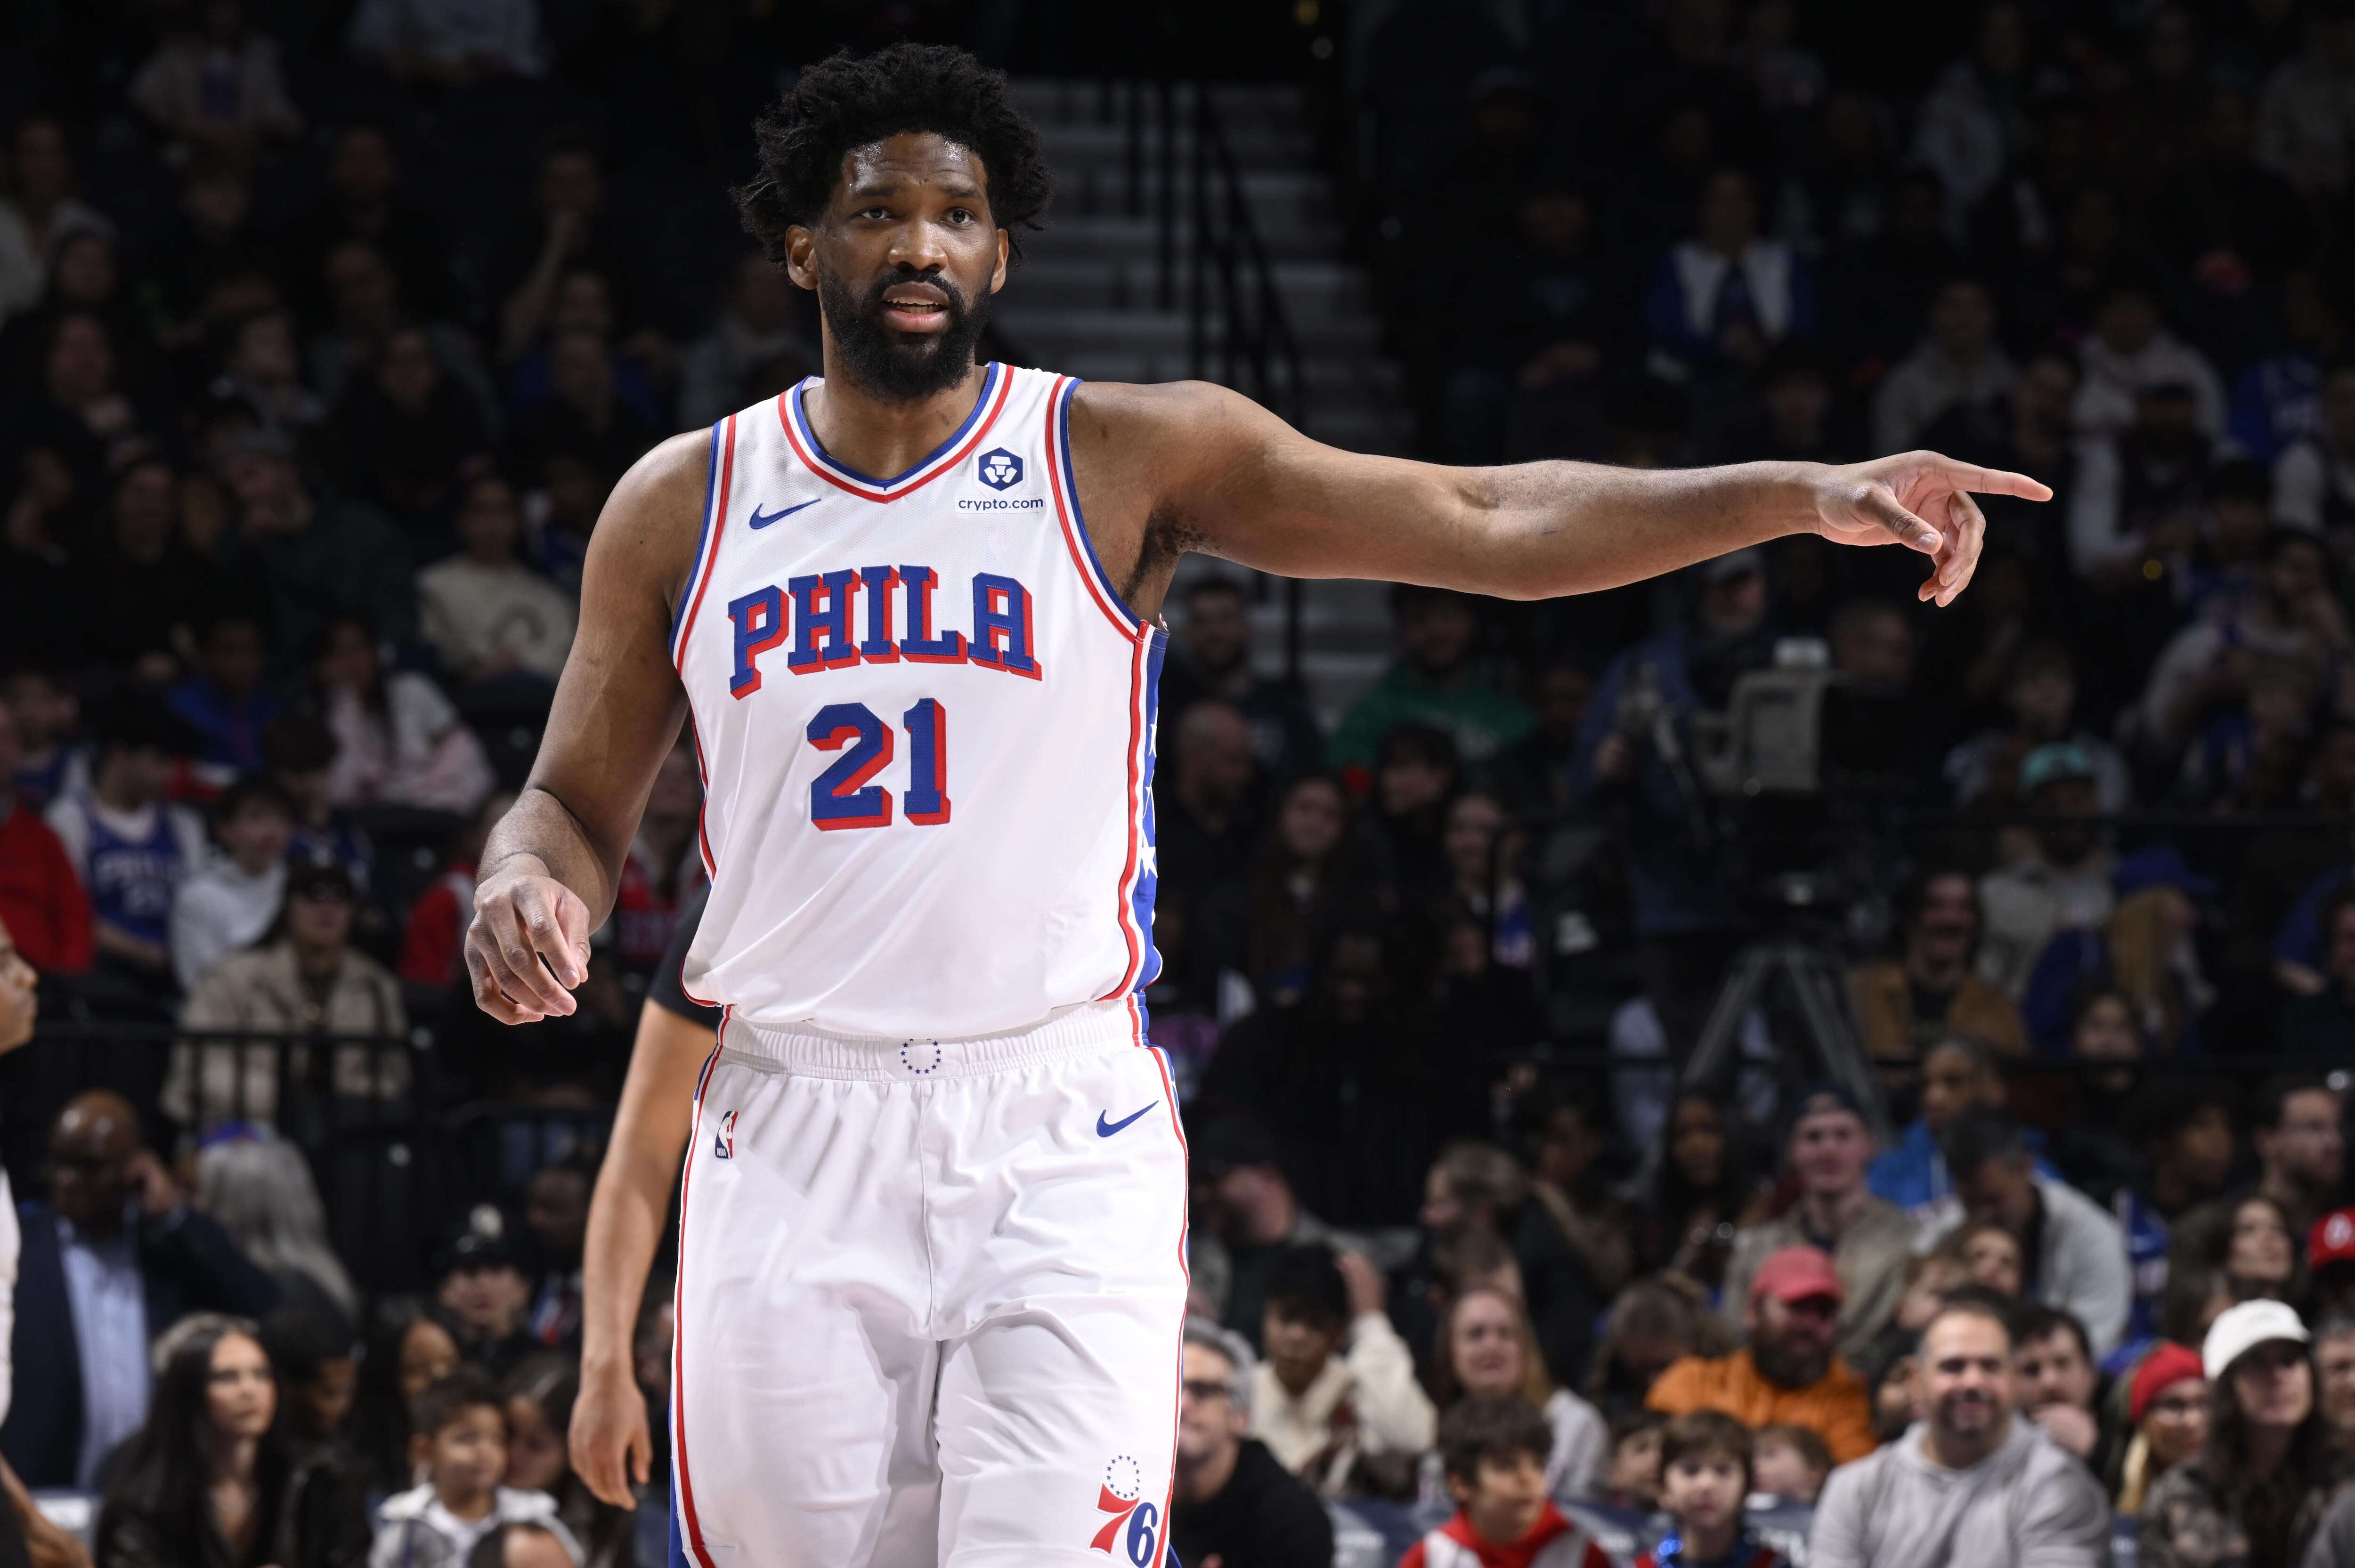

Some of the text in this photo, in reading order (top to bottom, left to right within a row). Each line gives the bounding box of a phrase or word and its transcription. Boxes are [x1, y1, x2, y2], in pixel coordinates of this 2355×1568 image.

[958, 499, 1043, 511] crypto.com
[728, 565, 1042, 701] PHILA
[806, 698, 951, 831] 21
[717, 1148, 726, 1156] NBA
[1089, 1483, 1158, 1568] 76
